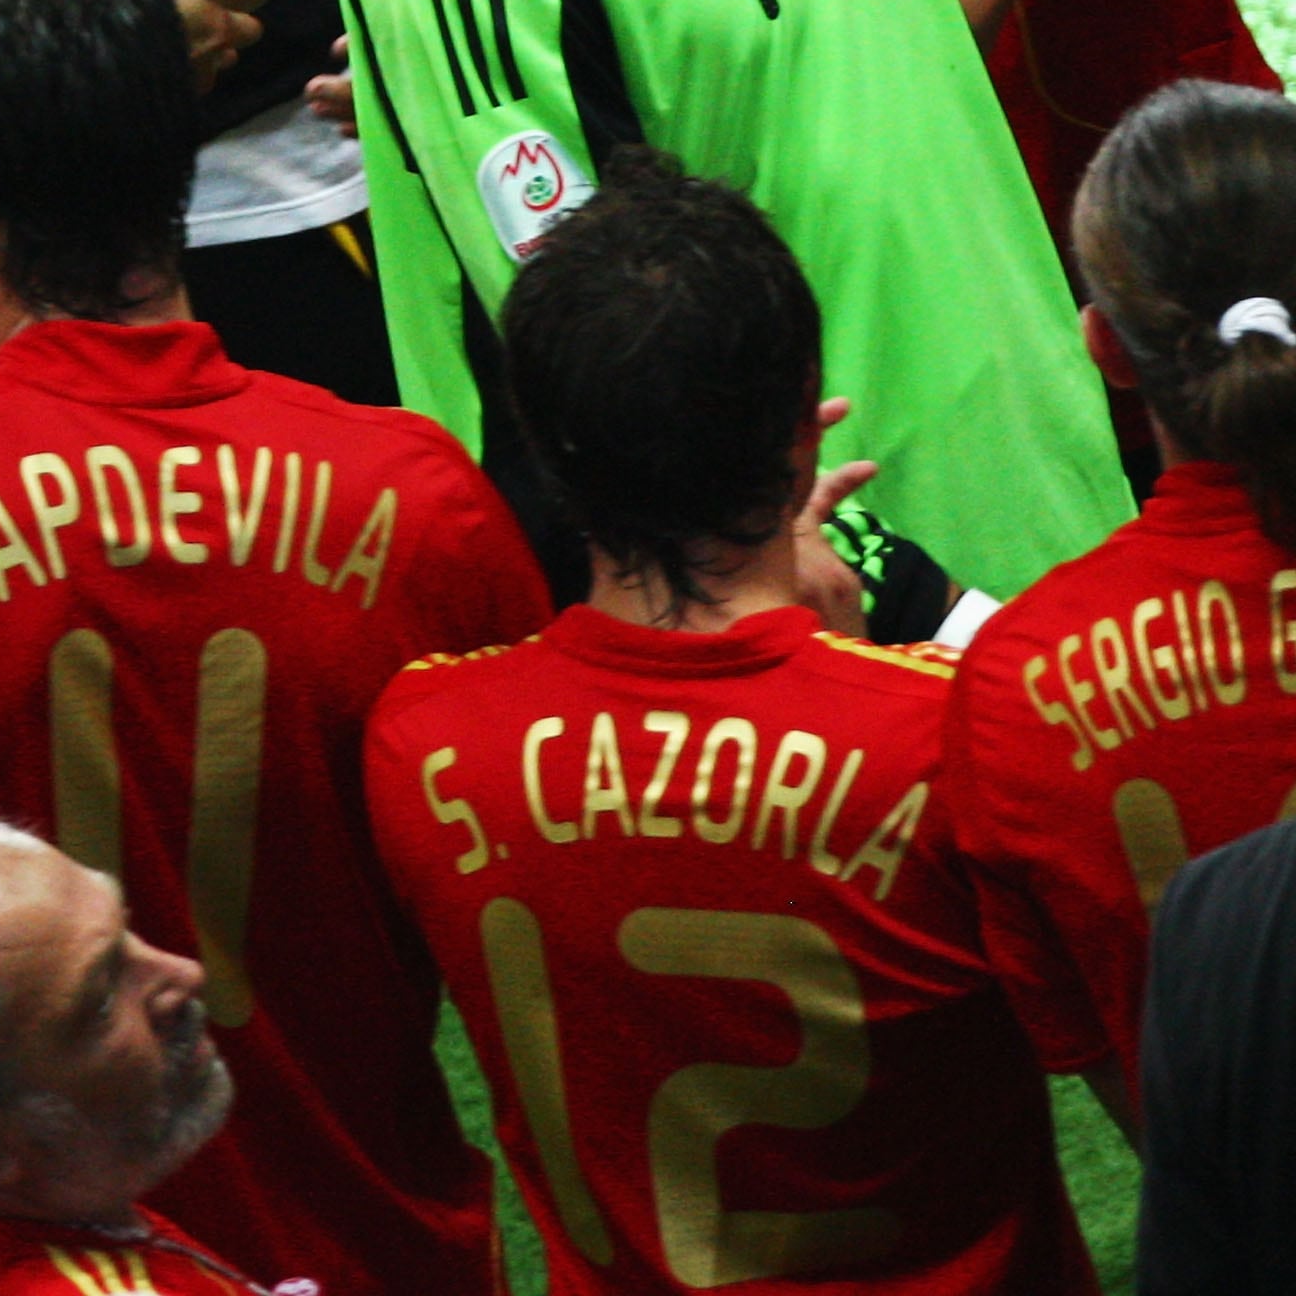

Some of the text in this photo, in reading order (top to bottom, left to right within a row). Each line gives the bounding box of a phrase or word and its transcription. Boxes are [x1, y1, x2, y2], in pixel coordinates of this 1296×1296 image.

[419, 745, 511, 876] S.
[521, 710, 931, 903] CAZORLA
[1021, 578, 1248, 773] SERGIO
[47, 627, 271, 1029] 11
[478, 896, 904, 1290] 12
